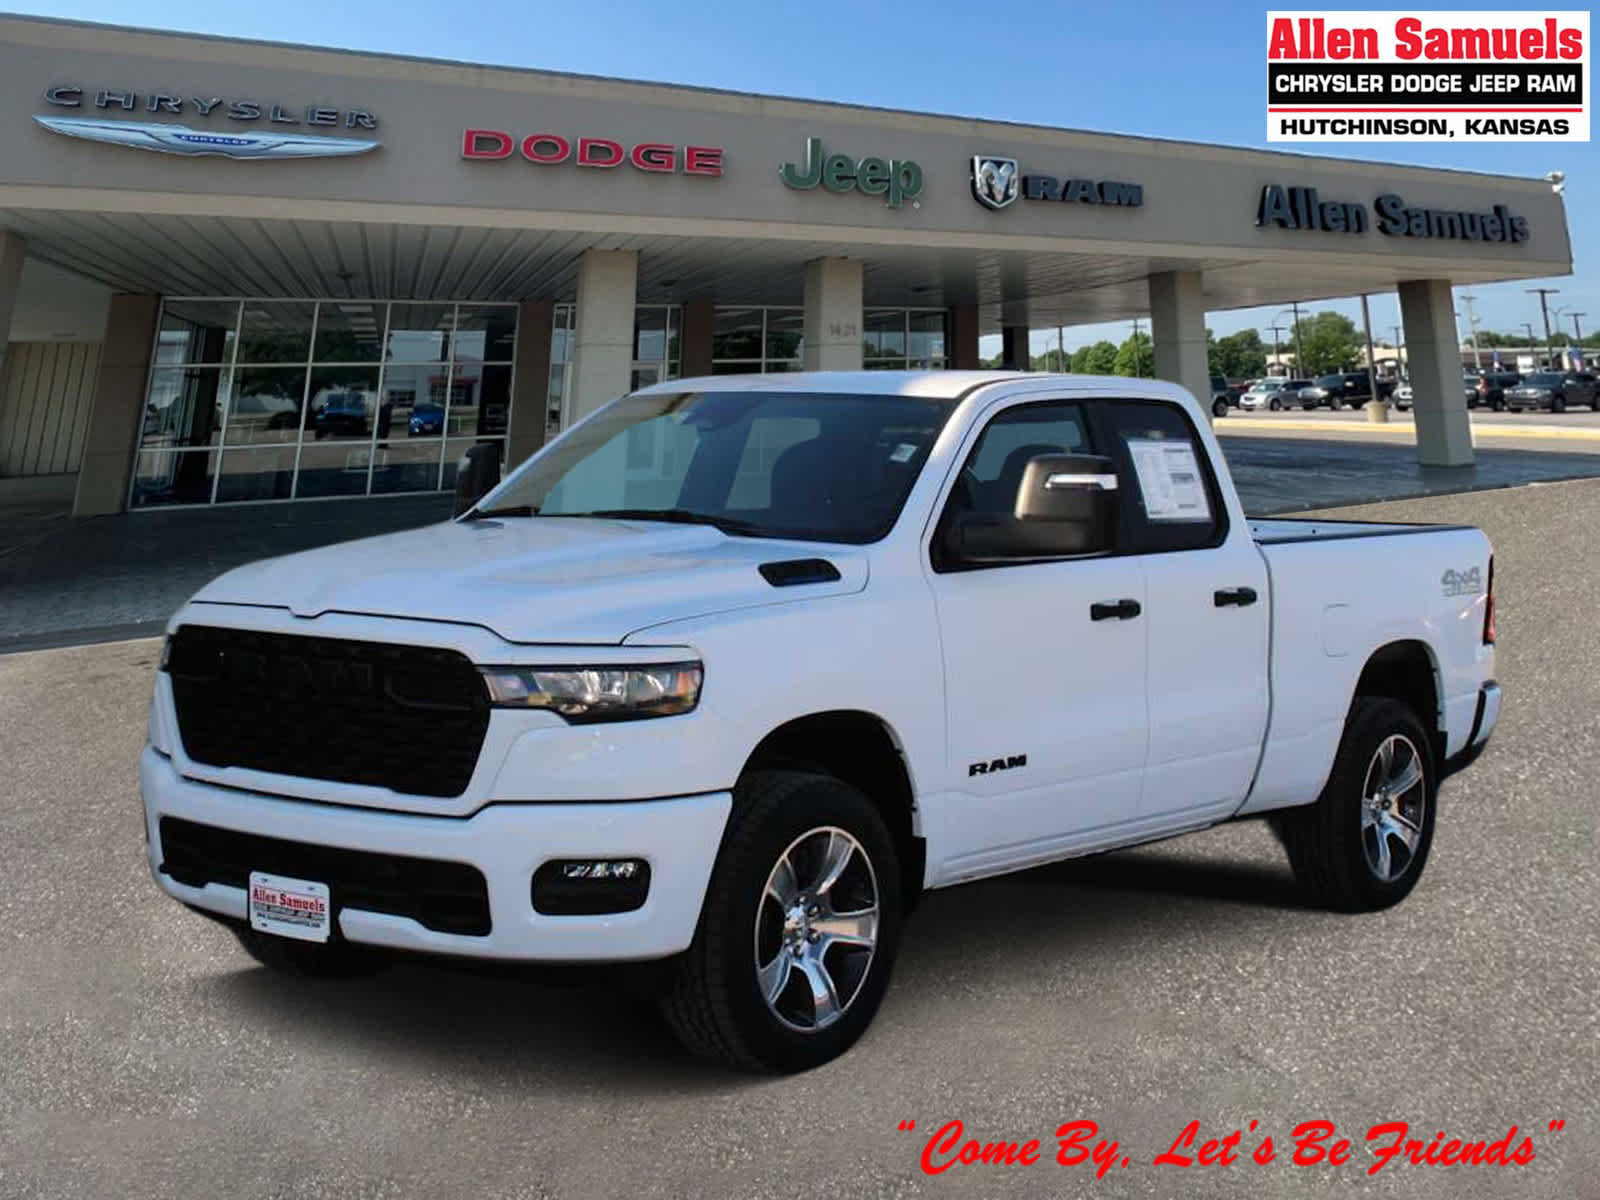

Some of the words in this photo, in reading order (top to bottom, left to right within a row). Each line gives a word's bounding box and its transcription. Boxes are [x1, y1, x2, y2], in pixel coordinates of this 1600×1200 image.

[44, 86, 377, 129] CHRYSLER
[461, 128, 725, 178] DODGE
[779, 136, 923, 209] Jeep
[1022, 175, 1145, 208] RAM
[1255, 184, 1370, 233] Allen
[1374, 194, 1531, 242] Samuels
[968, 753, 1027, 777] RAM
[253, 887, 278, 905] Allen
[280, 892, 326, 914] Samuels
